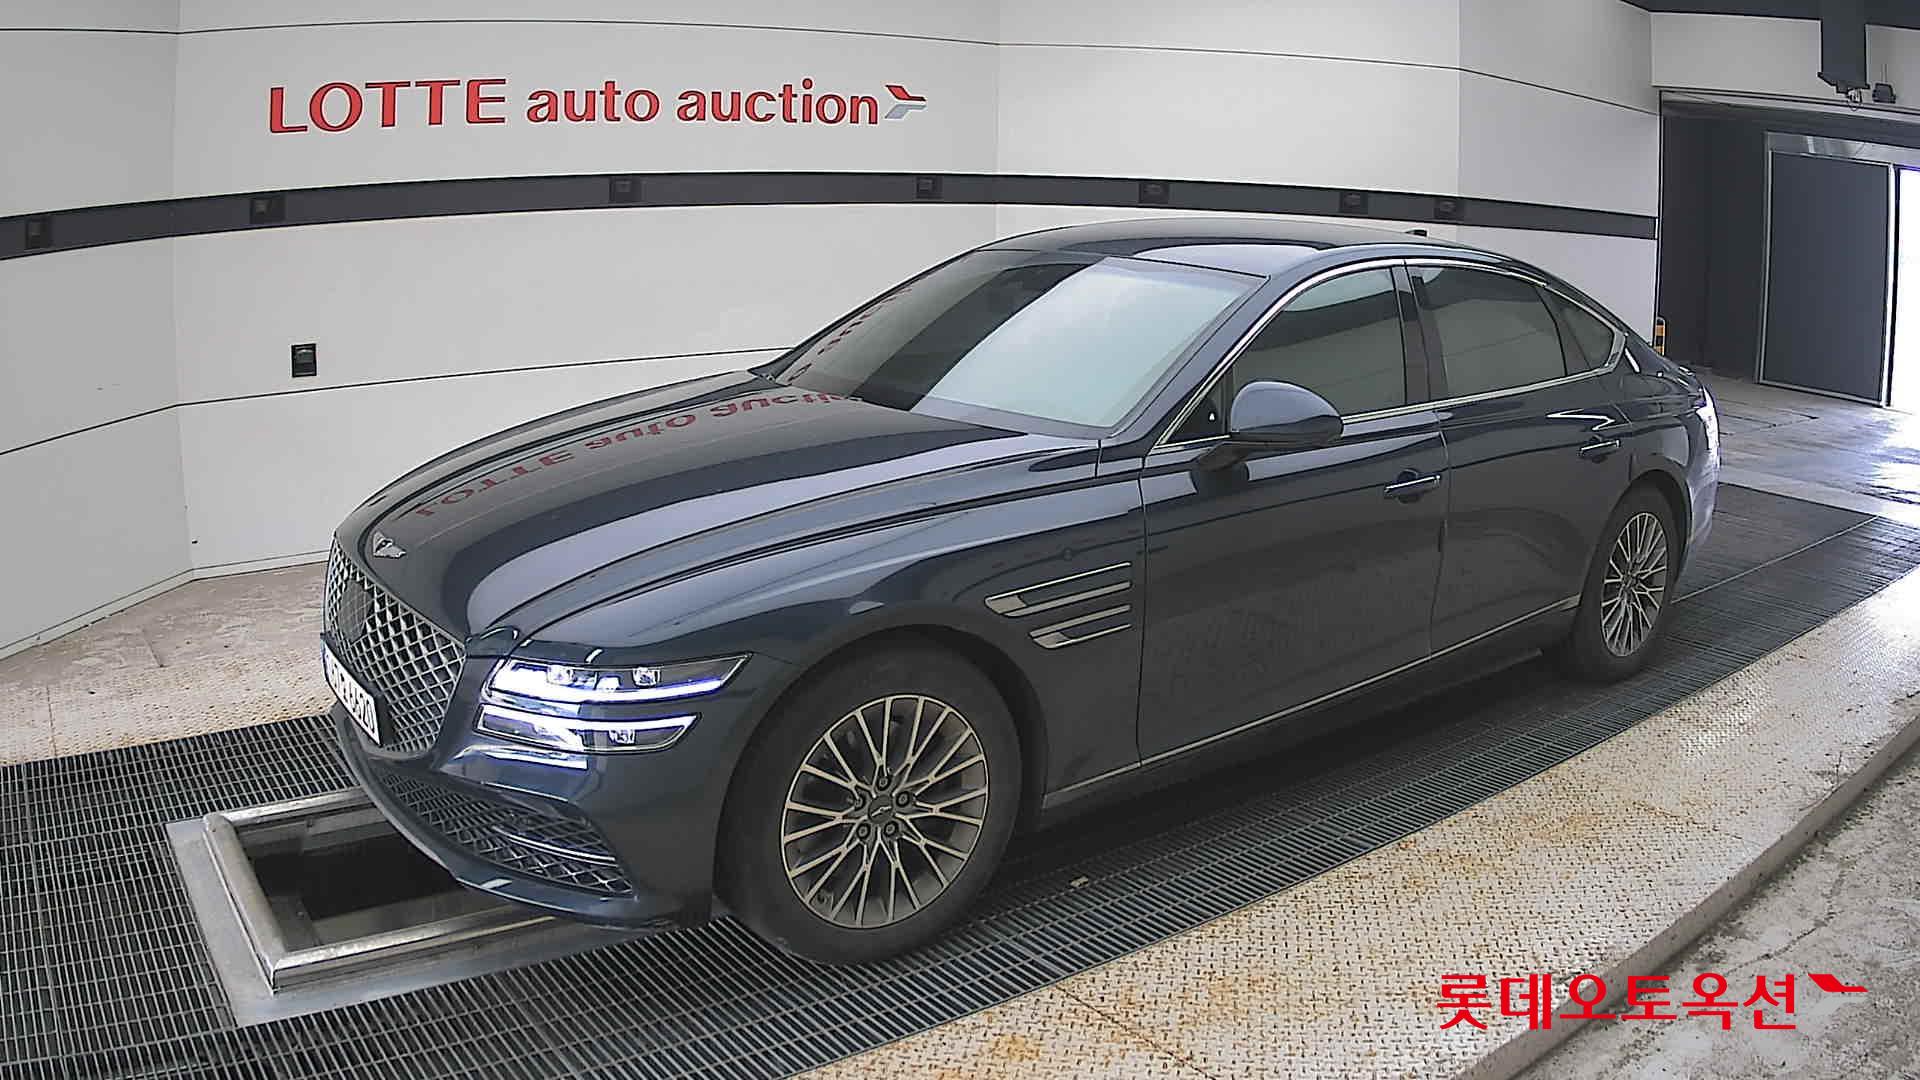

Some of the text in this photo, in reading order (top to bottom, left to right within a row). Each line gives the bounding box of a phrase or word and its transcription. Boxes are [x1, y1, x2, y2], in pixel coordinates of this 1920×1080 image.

[269, 77, 880, 134] LOTTE auto auction
